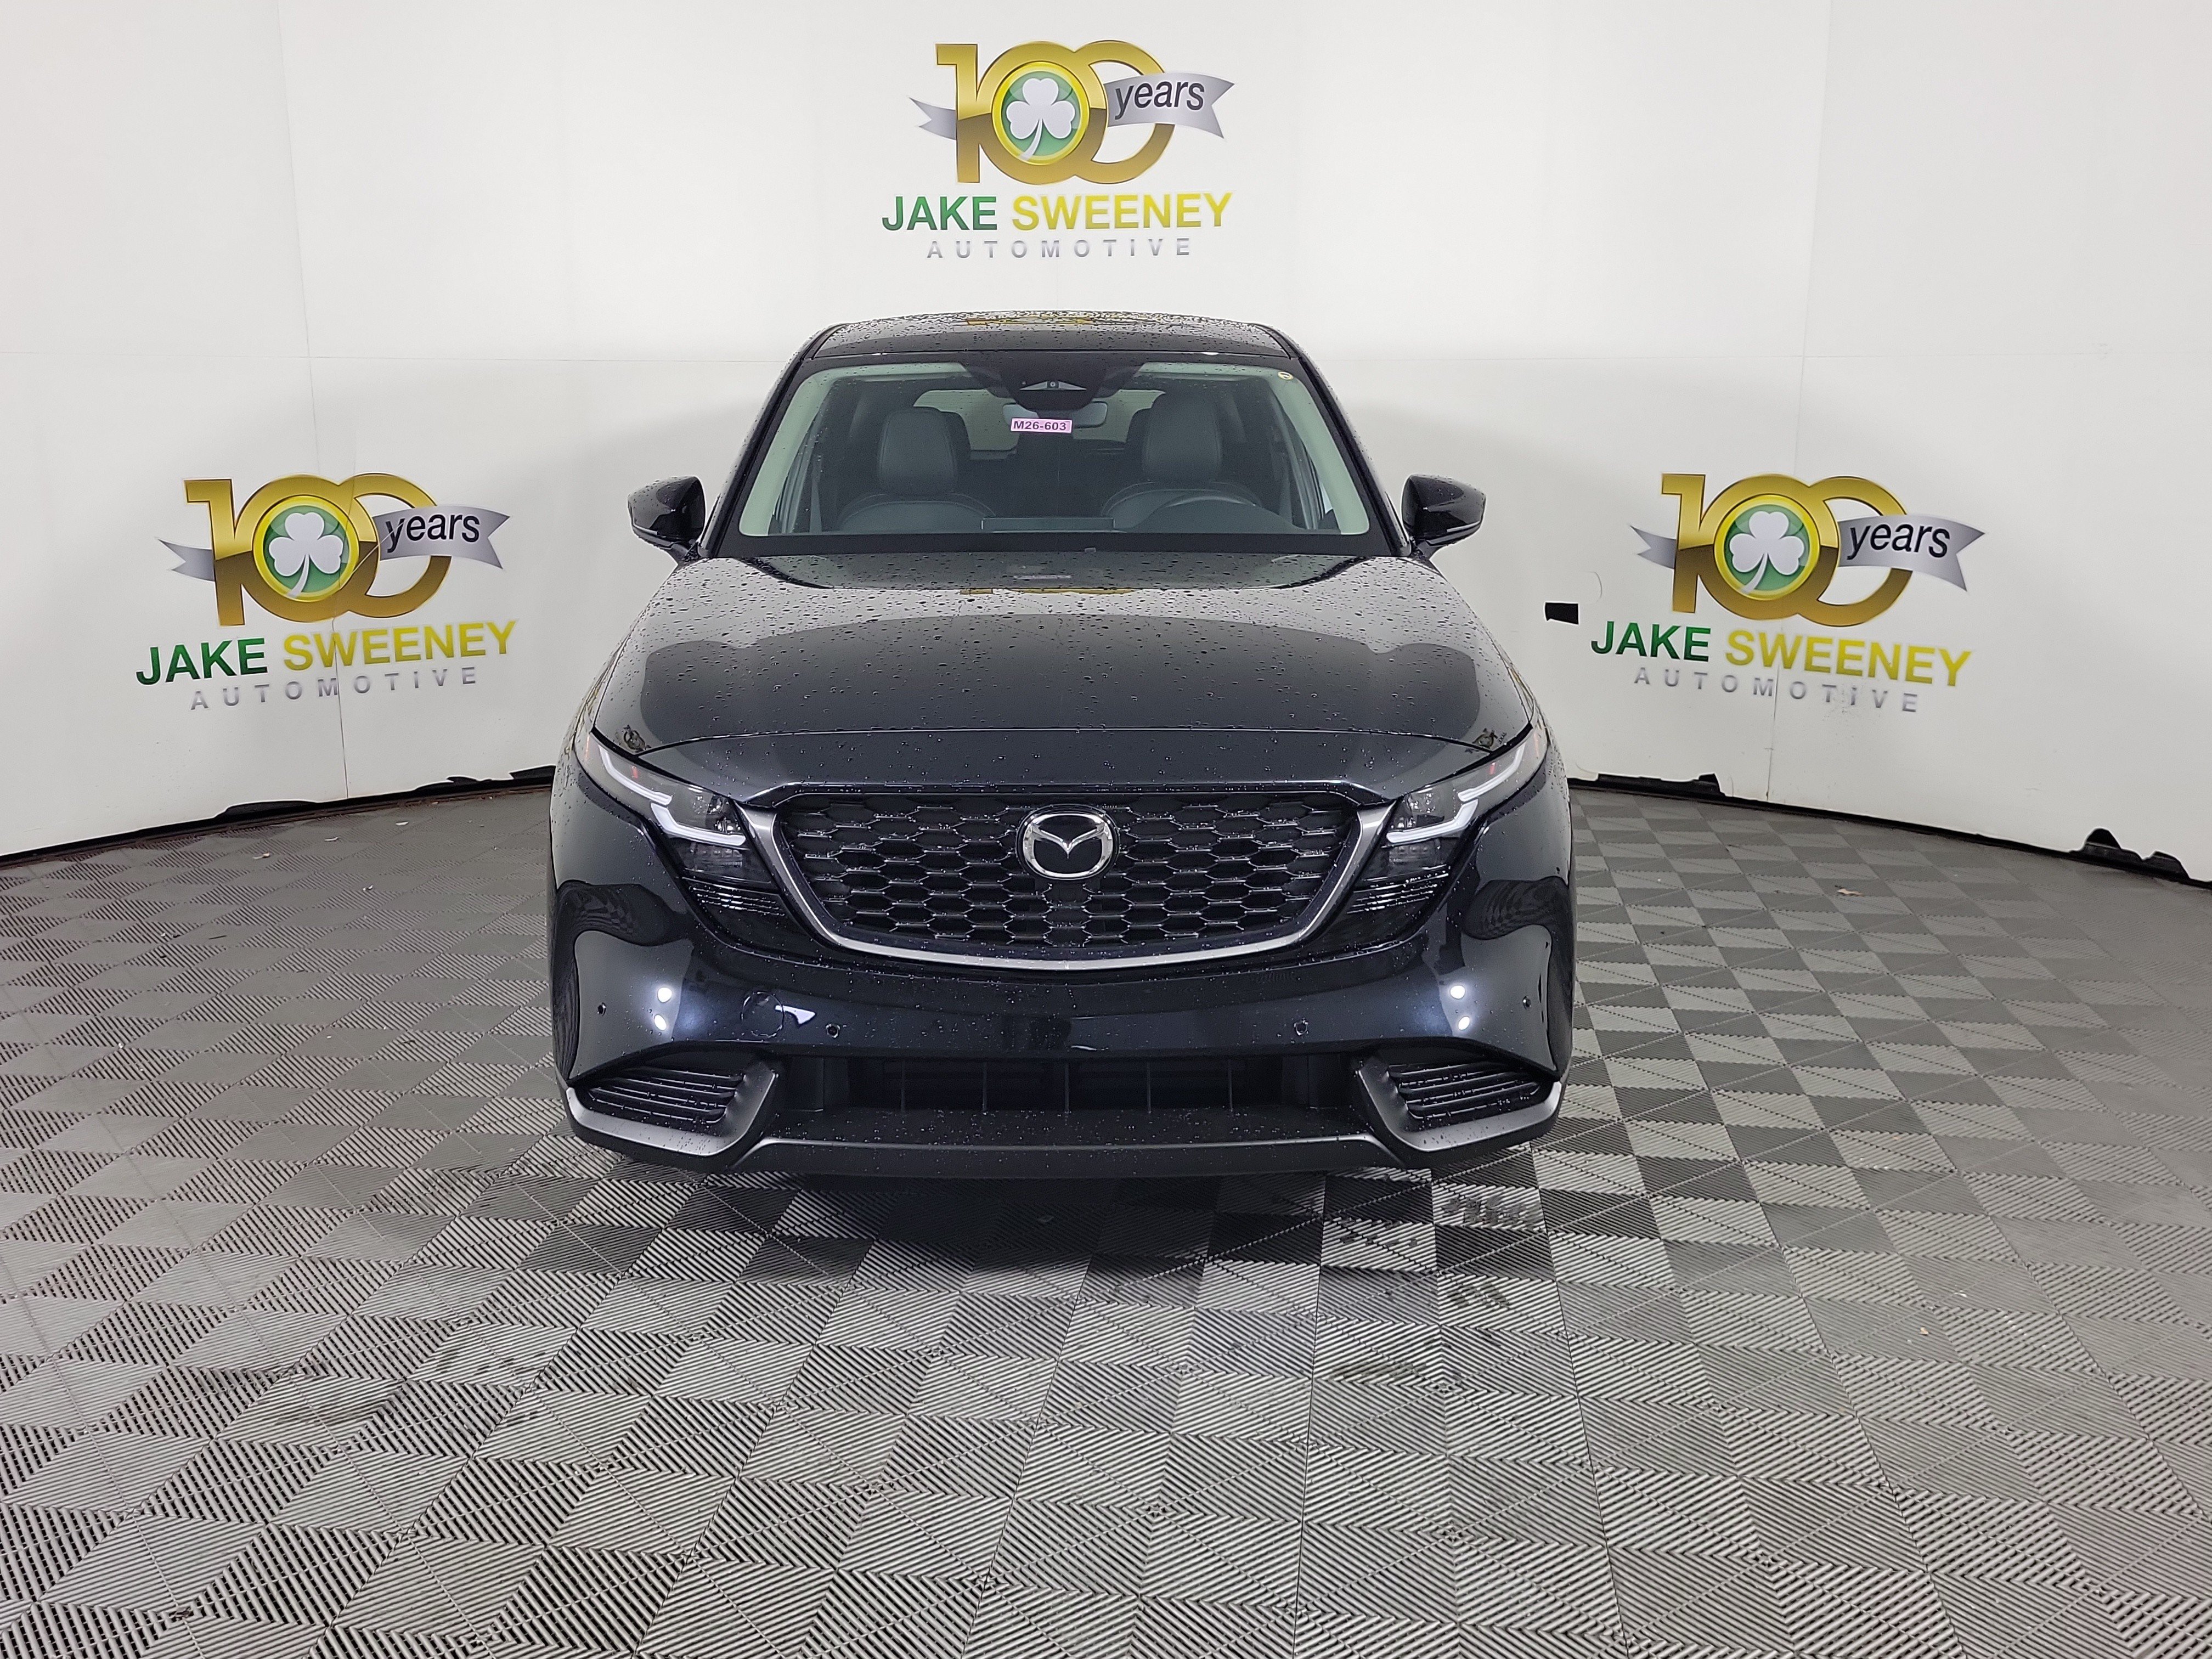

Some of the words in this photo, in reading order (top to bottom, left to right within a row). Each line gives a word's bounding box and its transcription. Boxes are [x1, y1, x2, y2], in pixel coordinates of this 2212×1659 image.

[935, 40, 1175, 185] 100
[1114, 80, 1205, 120] years
[882, 195, 997, 230] JAKE
[1012, 192, 1233, 230] SWEENEY
[927, 238, 1190, 258] AUTOMOTIVE
[1013, 420, 1066, 431] M26-603
[184, 473, 452, 627] 100
[386, 514, 481, 553] years
[1662, 473, 1912, 627] 100
[1847, 523, 1950, 560] years
[136, 637, 268, 685] JAKE
[284, 620, 517, 670] SWEENEY
[1591, 621, 1712, 662] JAKE
[1725, 630, 1972, 686] SWEENEY
[190, 667, 476, 710] AUTOMOTIVE
[1634, 667, 1918, 713] AUTOMOTIVE
